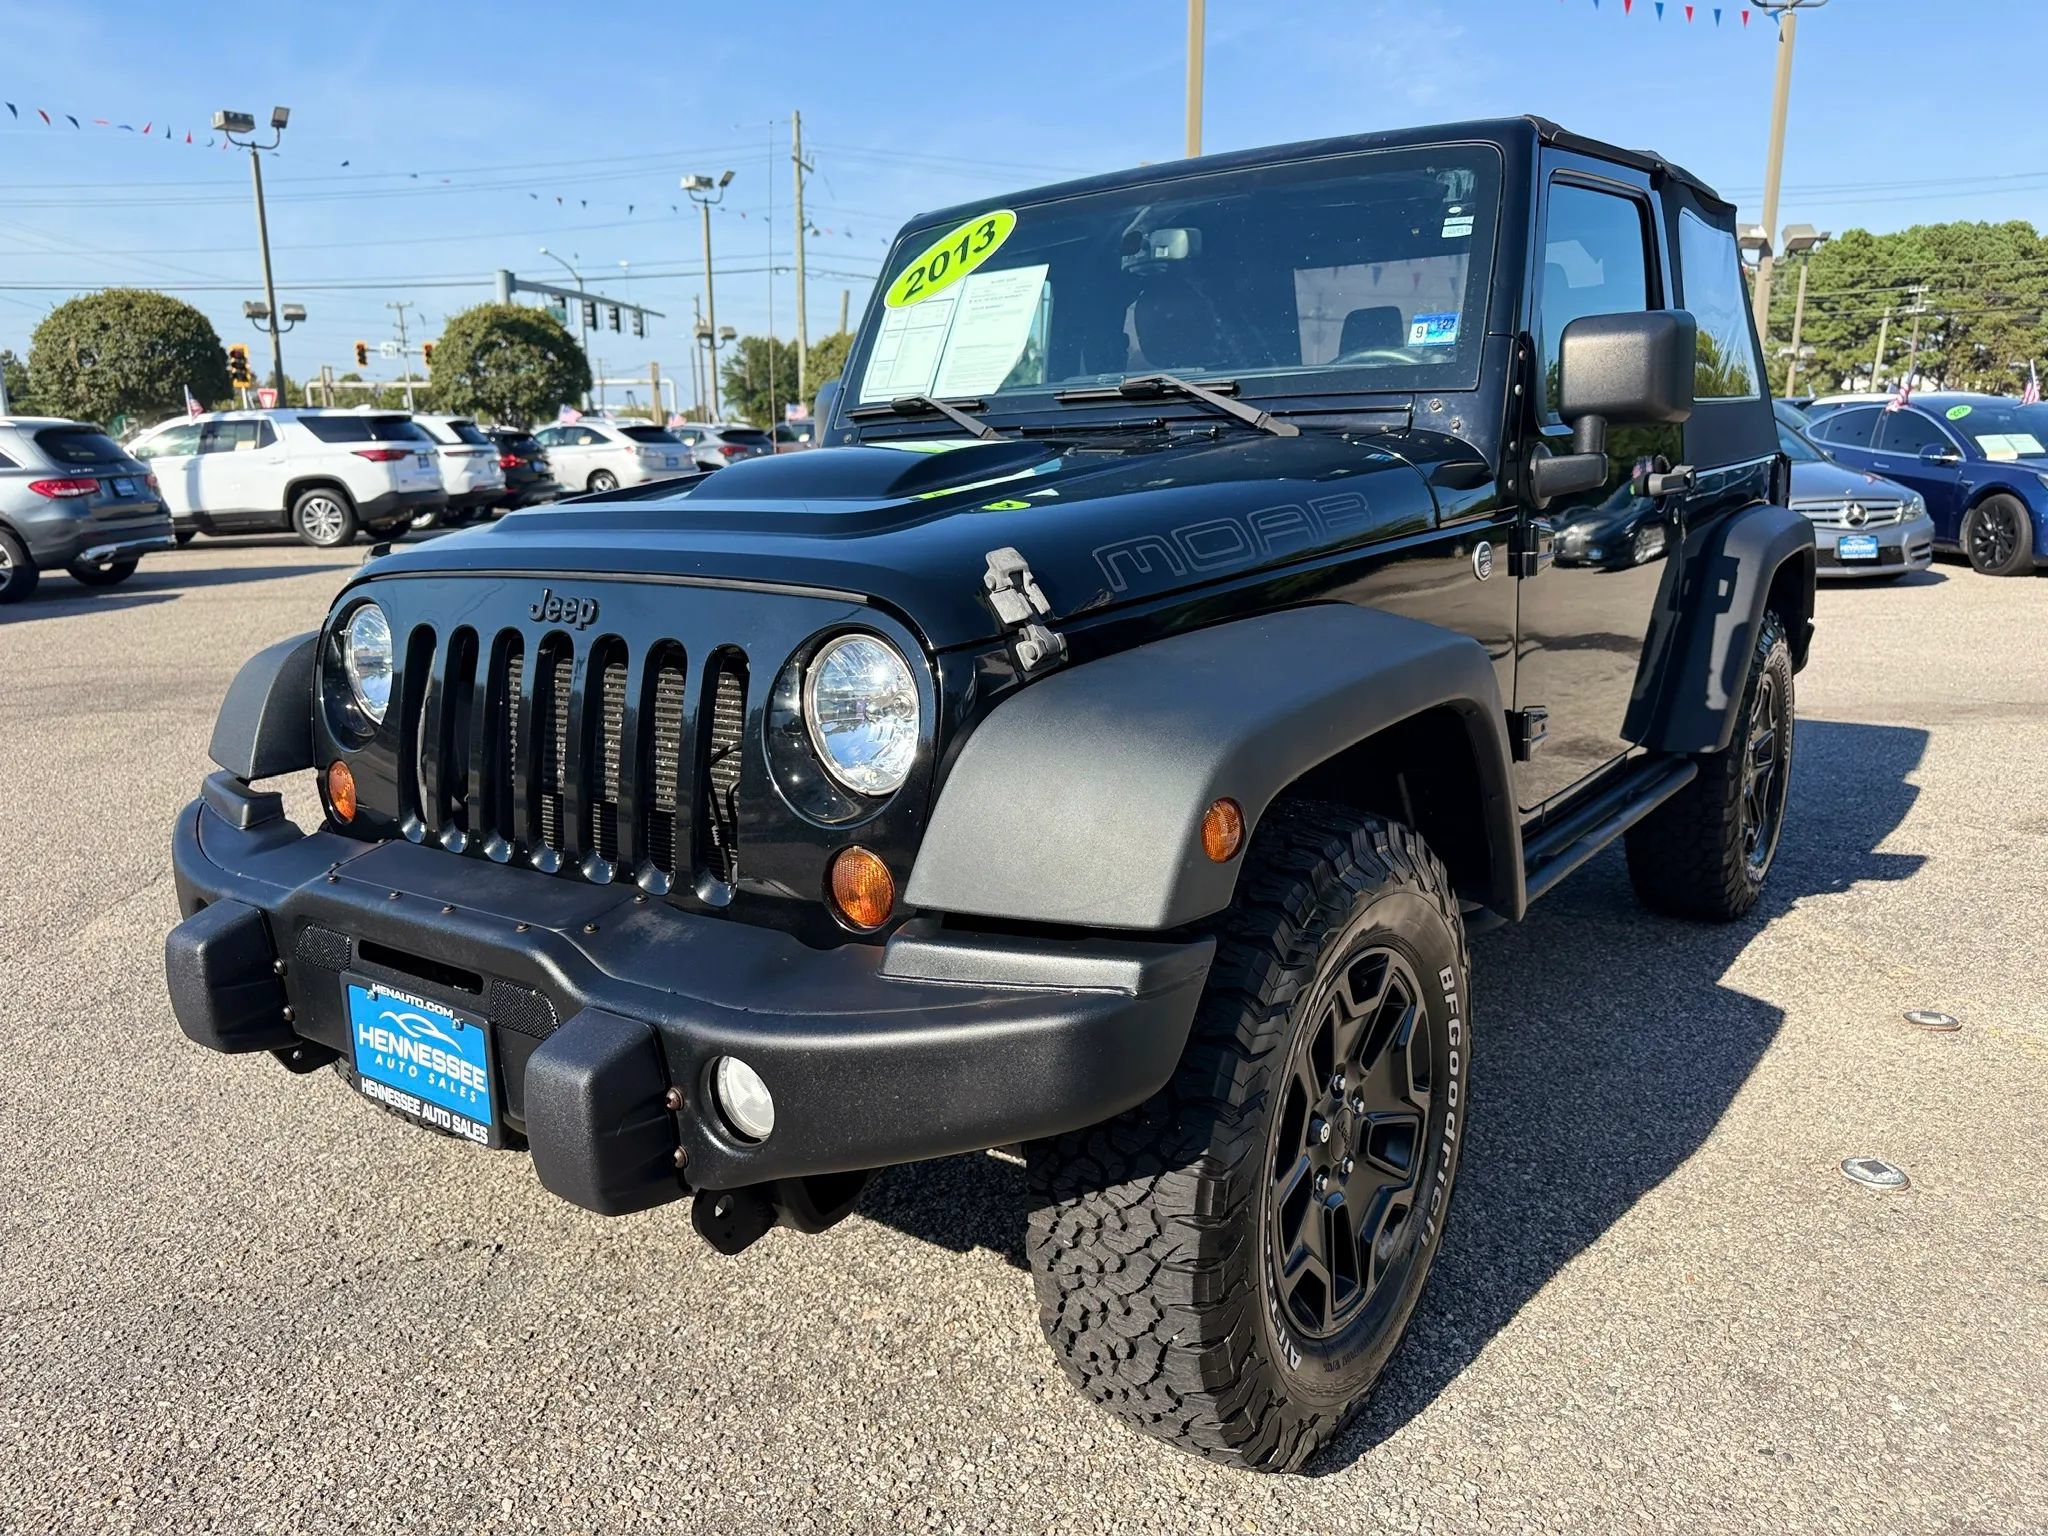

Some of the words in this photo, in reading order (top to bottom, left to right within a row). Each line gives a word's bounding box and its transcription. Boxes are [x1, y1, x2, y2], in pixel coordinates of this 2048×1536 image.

[901, 218, 997, 303] 2013
[1415, 325, 1424, 339] 9
[1092, 491, 1375, 593] MOAB
[528, 587, 601, 631] Jeep
[372, 984, 453, 1018] HENAUTO.COM
[359, 1024, 486, 1092] HENNESSEE
[375, 1054, 418, 1077] AUTO
[428, 1072, 477, 1104] SALES
[361, 1077, 421, 1117] HENNESSEE
[421, 1102, 451, 1130] AUTO
[452, 1115, 488, 1144] SALES
